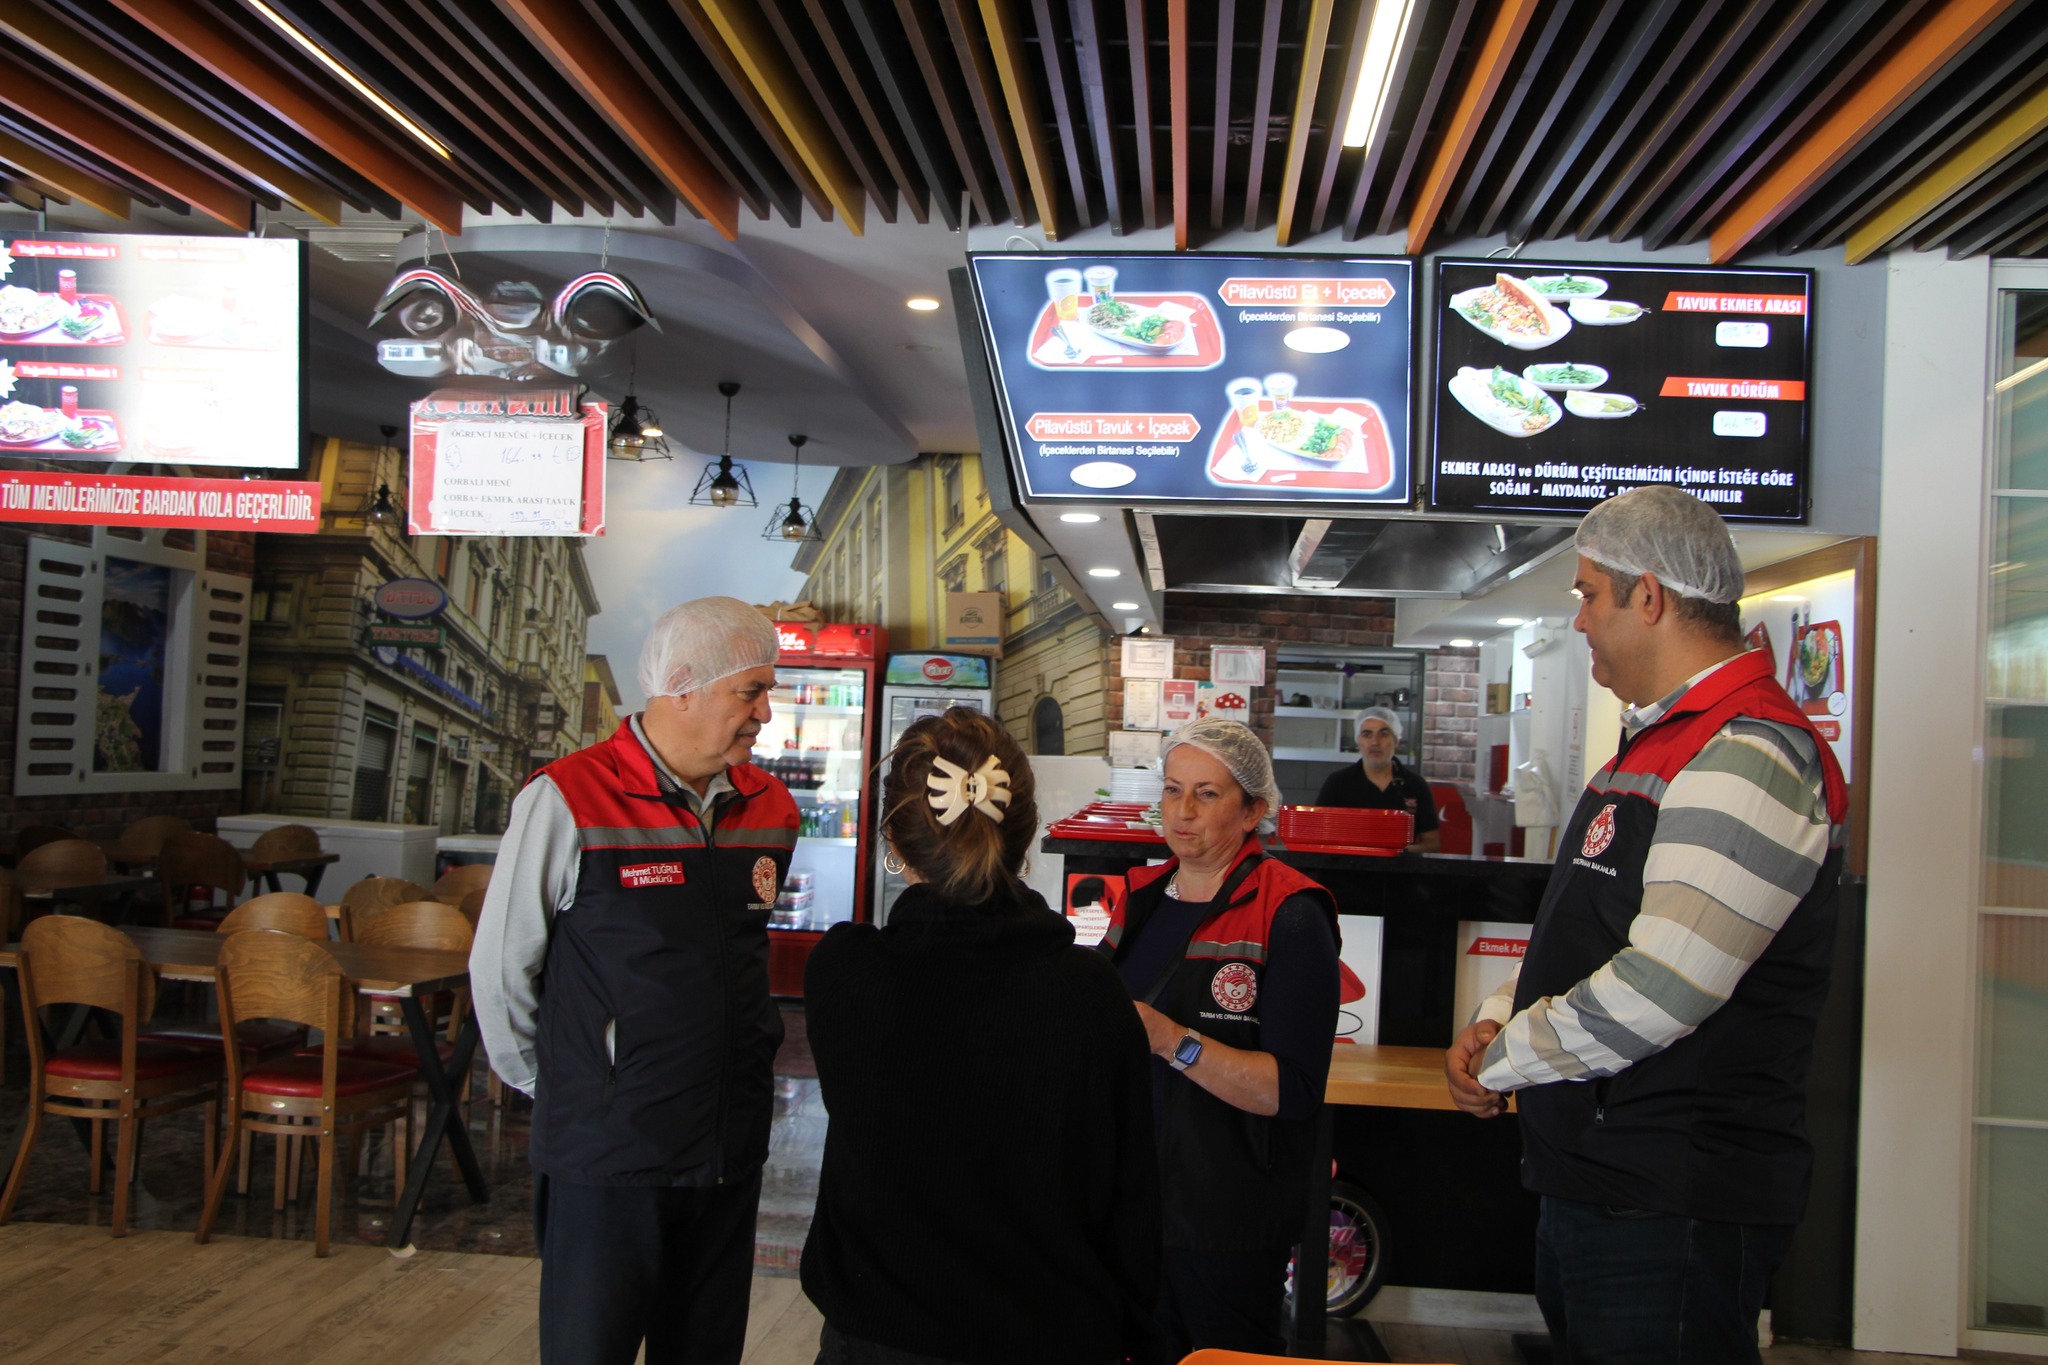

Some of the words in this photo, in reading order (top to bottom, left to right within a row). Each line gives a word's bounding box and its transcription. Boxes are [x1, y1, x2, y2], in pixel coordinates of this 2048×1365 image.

[1228, 283, 1297, 300] Pilavüstü
[1301, 284, 1318, 300] Et
[1322, 286, 1332, 298] +
[1337, 282, 1387, 303] İçecek
[1677, 297, 1718, 311] TAVUK
[1720, 297, 1763, 312] EKMEK
[1765, 298, 1801, 313] ARASI
[1687, 382, 1729, 397] TAVUK
[1731, 381, 1778, 398] DÜRÜM
[1035, 418, 1092, 435] Pilavüstü
[1095, 419, 1133, 435] Tavuk
[1136, 423, 1145, 433] +
[1149, 417, 1190, 438] İçecek
[539, 431, 573, 441] İÇECEK
[1097, 446, 1134, 455] Birtanesi
[1441, 461, 1480, 476] EKMEK
[1482, 463, 1516, 477] ARASI
[1518, 466, 1532, 477] ve
[1535, 462, 1579, 480] DÜRÜM
[1581, 464, 1672, 484] ÇEŞİTLERİMİZİN
[1675, 466, 1716, 486] İÇİNDE
[1718, 467, 1758, 485] İSTEĞE
[1760, 468, 1793, 486] GÖRE
[444, 478, 485, 489] ÇORBALI
[487, 478, 512, 487] MENÜ
[1490, 478, 1531, 496] SOĞAN
[1541, 483, 1606, 499] MAYDANOZ
[2, 479, 31, 510] TÜM
[33, 481, 141, 515] MENÜLERİMİZDE
[142, 489, 195, 517] BARDAK
[199, 491, 233, 518] KOLA
[236, 490, 315, 524] GEÇERLİDİR.
[481, 496, 514, 504] EKMEK
[545, 497, 576, 506] TAVUK
[450, 510, 484, 520] İÇECEK
[622, 865, 651, 878] Mehmet
[651, 863, 681, 875] TUĞRUL
[639, 875, 673, 886] Müdürü
[1479, 941, 1509, 953] Ekmek
[1199, 1011, 1216, 1019] TARIM
[1224, 1013, 1243, 1021] ORMAN
